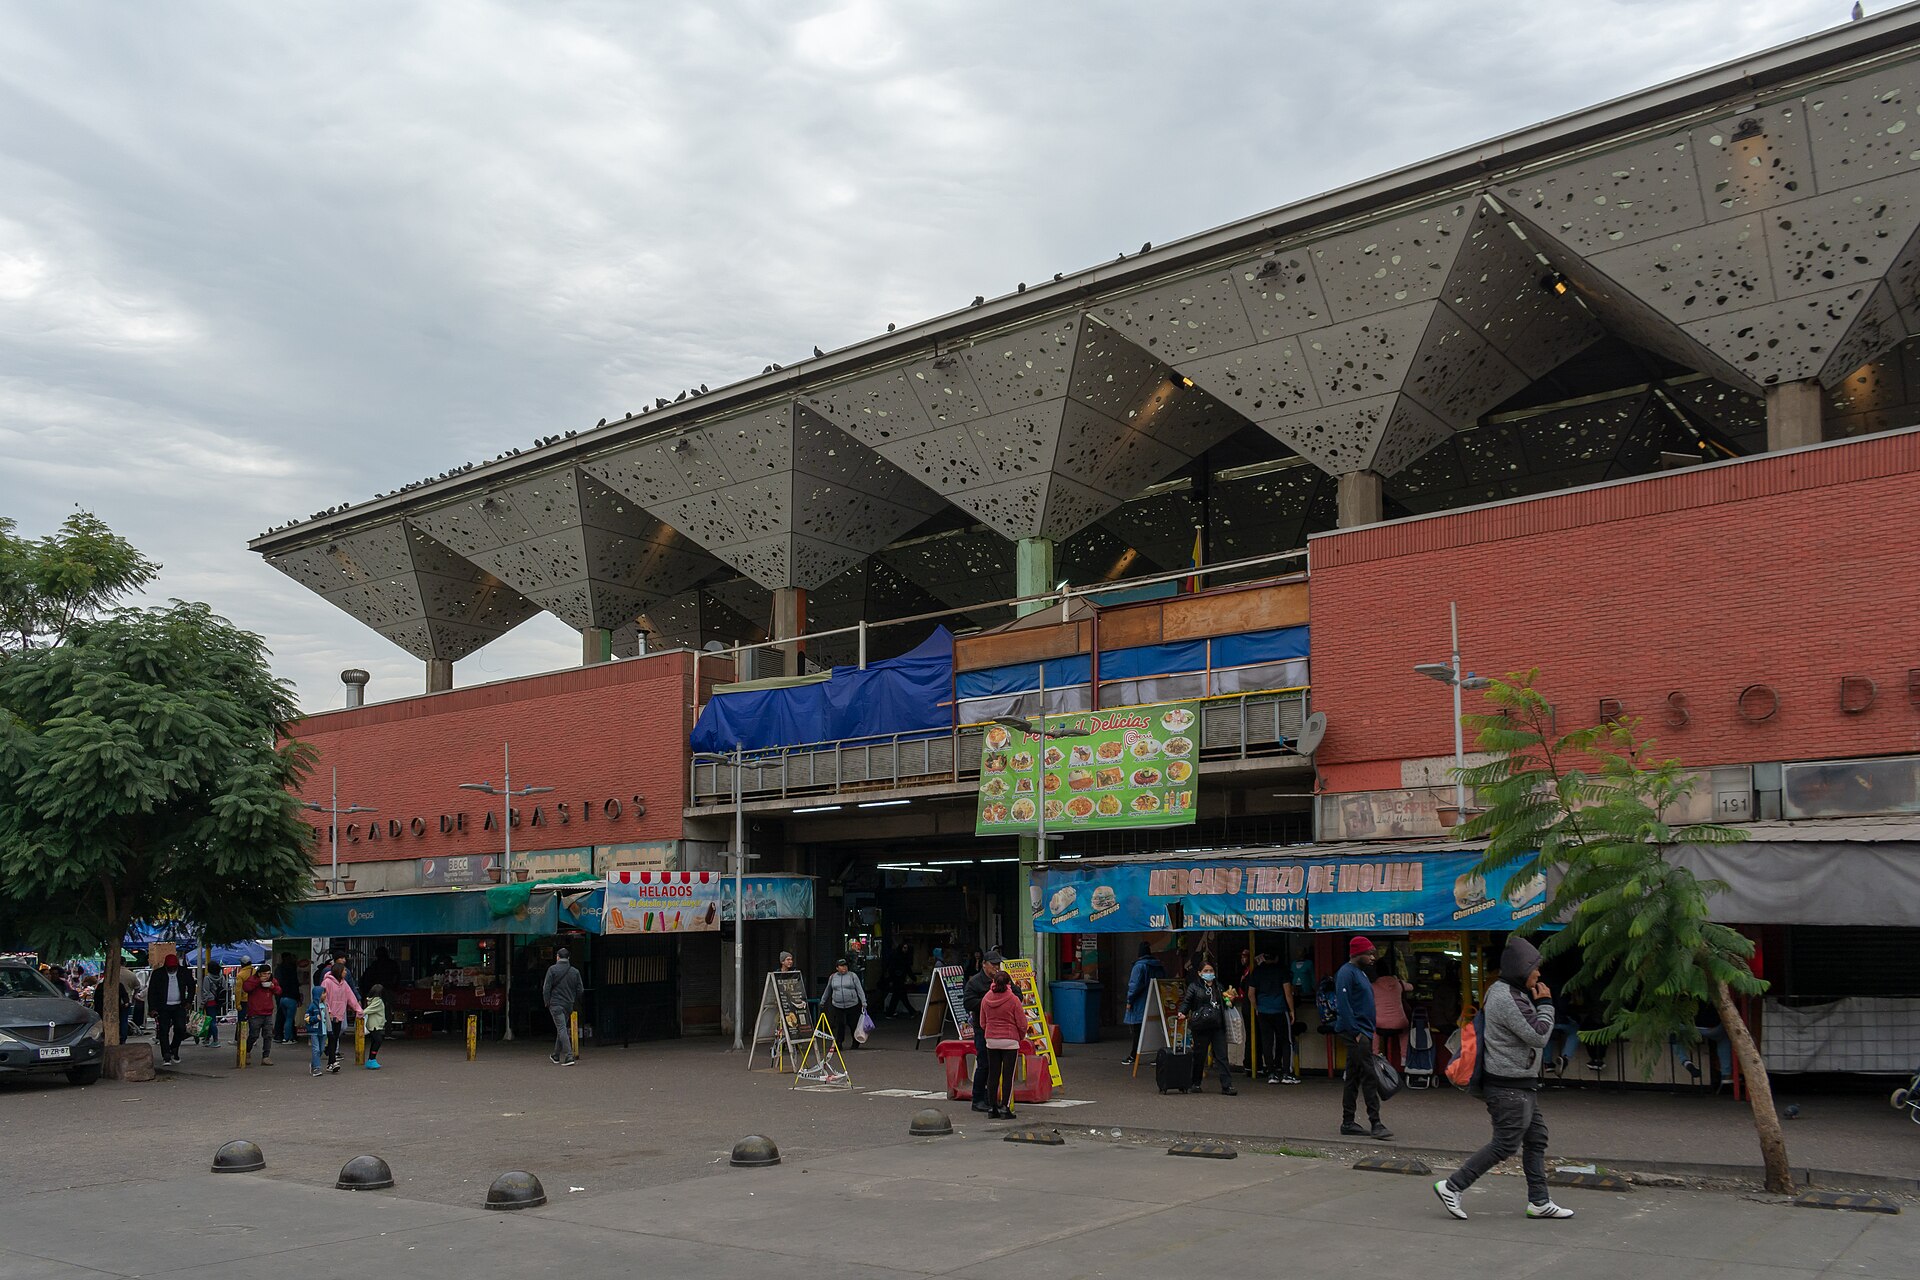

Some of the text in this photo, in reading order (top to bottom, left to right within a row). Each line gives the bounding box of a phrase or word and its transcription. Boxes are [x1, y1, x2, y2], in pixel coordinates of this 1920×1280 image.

[1089, 712, 1151, 735] Delicias
[1722, 799, 1748, 813] 191
[312, 817, 426, 842] ECADO
[440, 813, 470, 834] DE
[1149, 862, 1423, 896] MERCADO TIRZO DE MOLINA
[639, 885, 693, 898] HELADOS
[581, 906, 603, 917] pep
[1246, 899, 1270, 911] LOCAL
[1271, 898, 1286, 911] 189
[1288, 898, 1294, 911] Y
[1453, 900, 1496, 920] Churrascos
[1200, 914, 1248, 927] COMPLETOS
[1321, 913, 1376, 927] EMPANADAS
